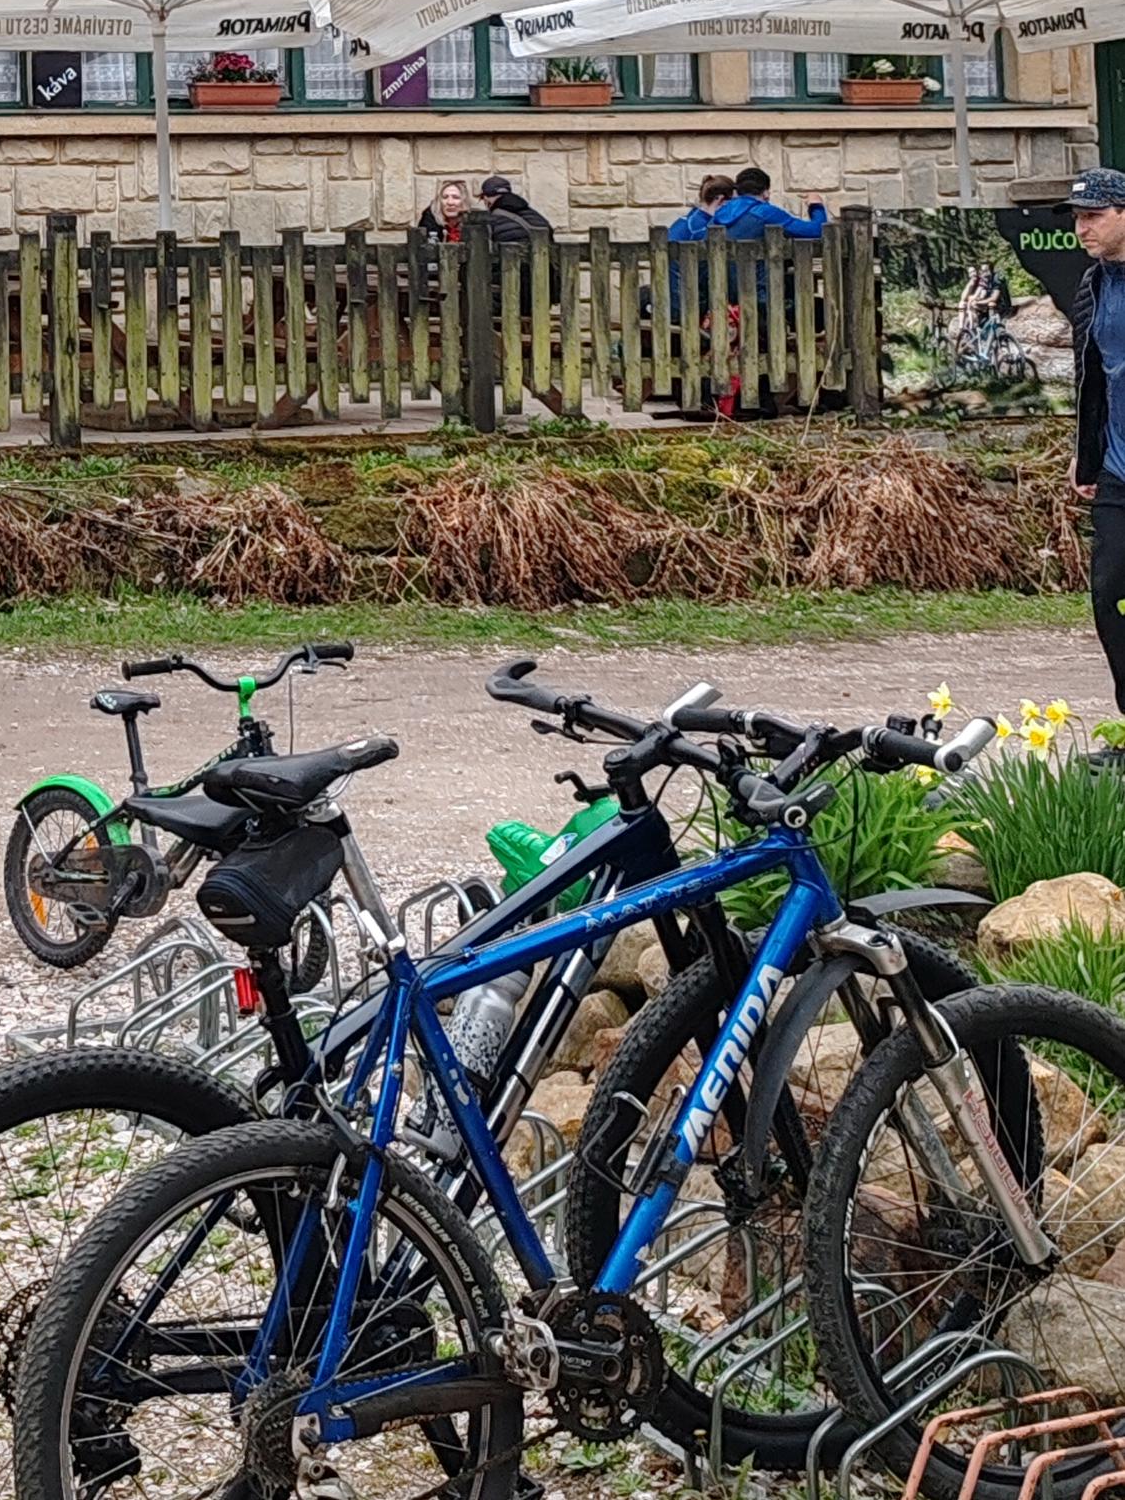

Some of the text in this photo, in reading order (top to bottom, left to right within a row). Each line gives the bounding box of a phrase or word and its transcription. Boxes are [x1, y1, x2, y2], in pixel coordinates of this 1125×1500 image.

[514, 10, 576, 42] PRIMATOR
[37, 66, 78, 100] káva
[682, 963, 784, 1162] MERIDA
[399, 1192, 475, 1283] MICHELIN Country
